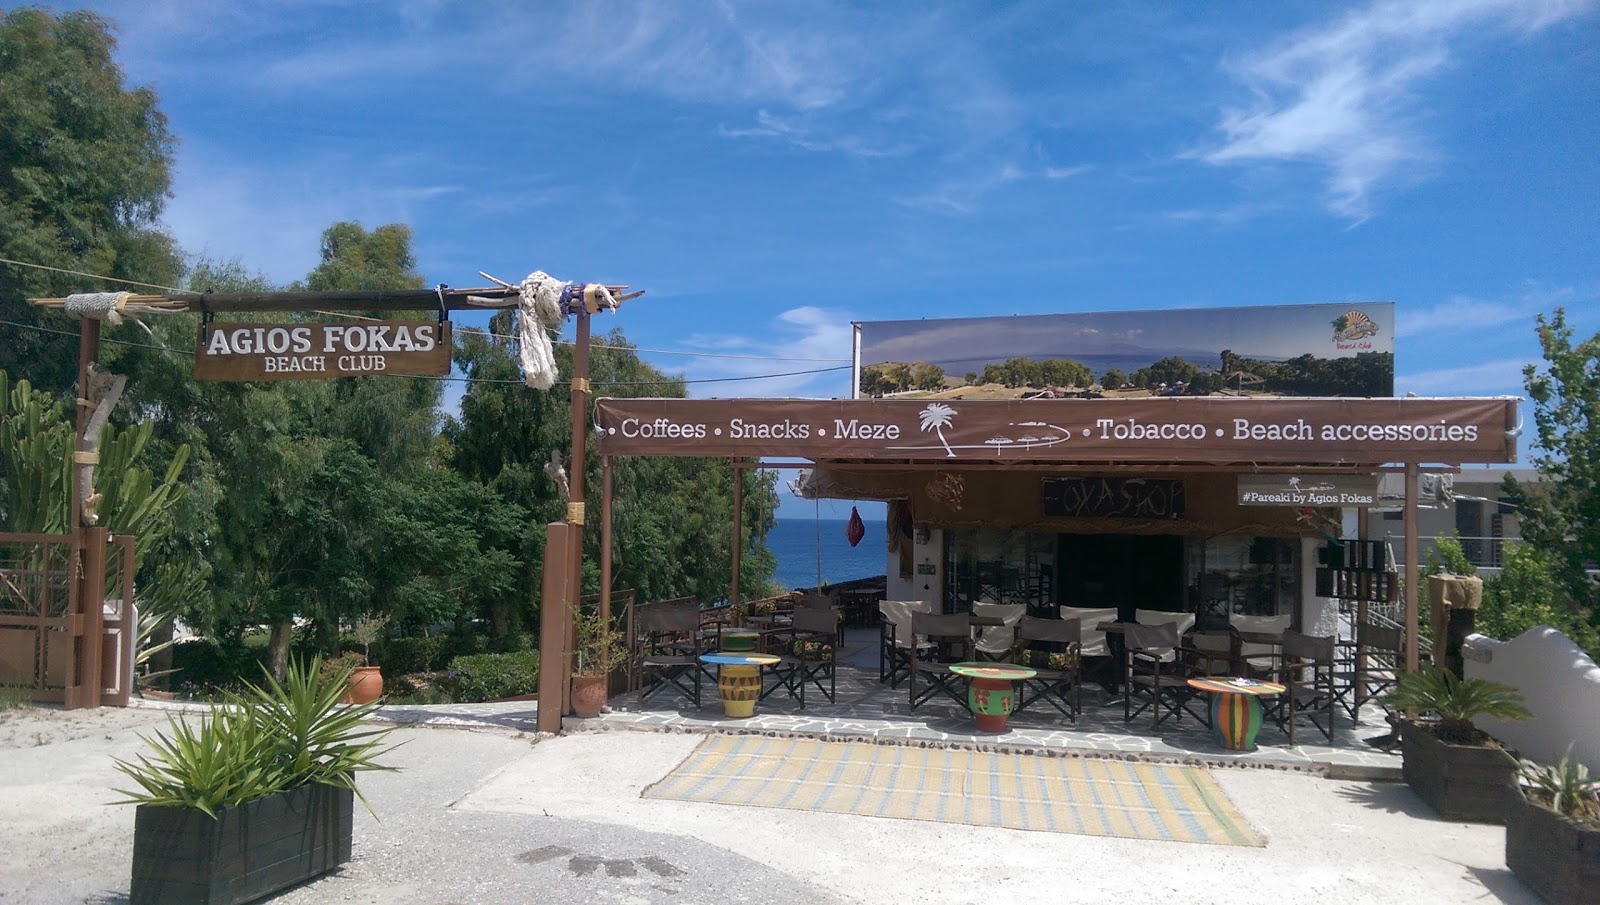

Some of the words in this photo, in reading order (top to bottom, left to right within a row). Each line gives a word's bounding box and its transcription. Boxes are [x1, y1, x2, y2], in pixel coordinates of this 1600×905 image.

[206, 328, 311, 355] AGIOS
[323, 325, 435, 353] FOKAS
[264, 356, 326, 373] BEACH
[337, 355, 386, 371] CLUB
[621, 418, 706, 439] Coffees
[730, 418, 810, 439] Snacks
[834, 419, 900, 440] Meze
[1097, 419, 1206, 440] Tobacco
[1233, 418, 1314, 441] Beach
[1321, 419, 1478, 442] accessories
[1242, 492, 1290, 503] #Pareaki
[1293, 492, 1305, 504] by
[1307, 492, 1338, 504] Agios
[1340, 493, 1373, 503] Fokas
